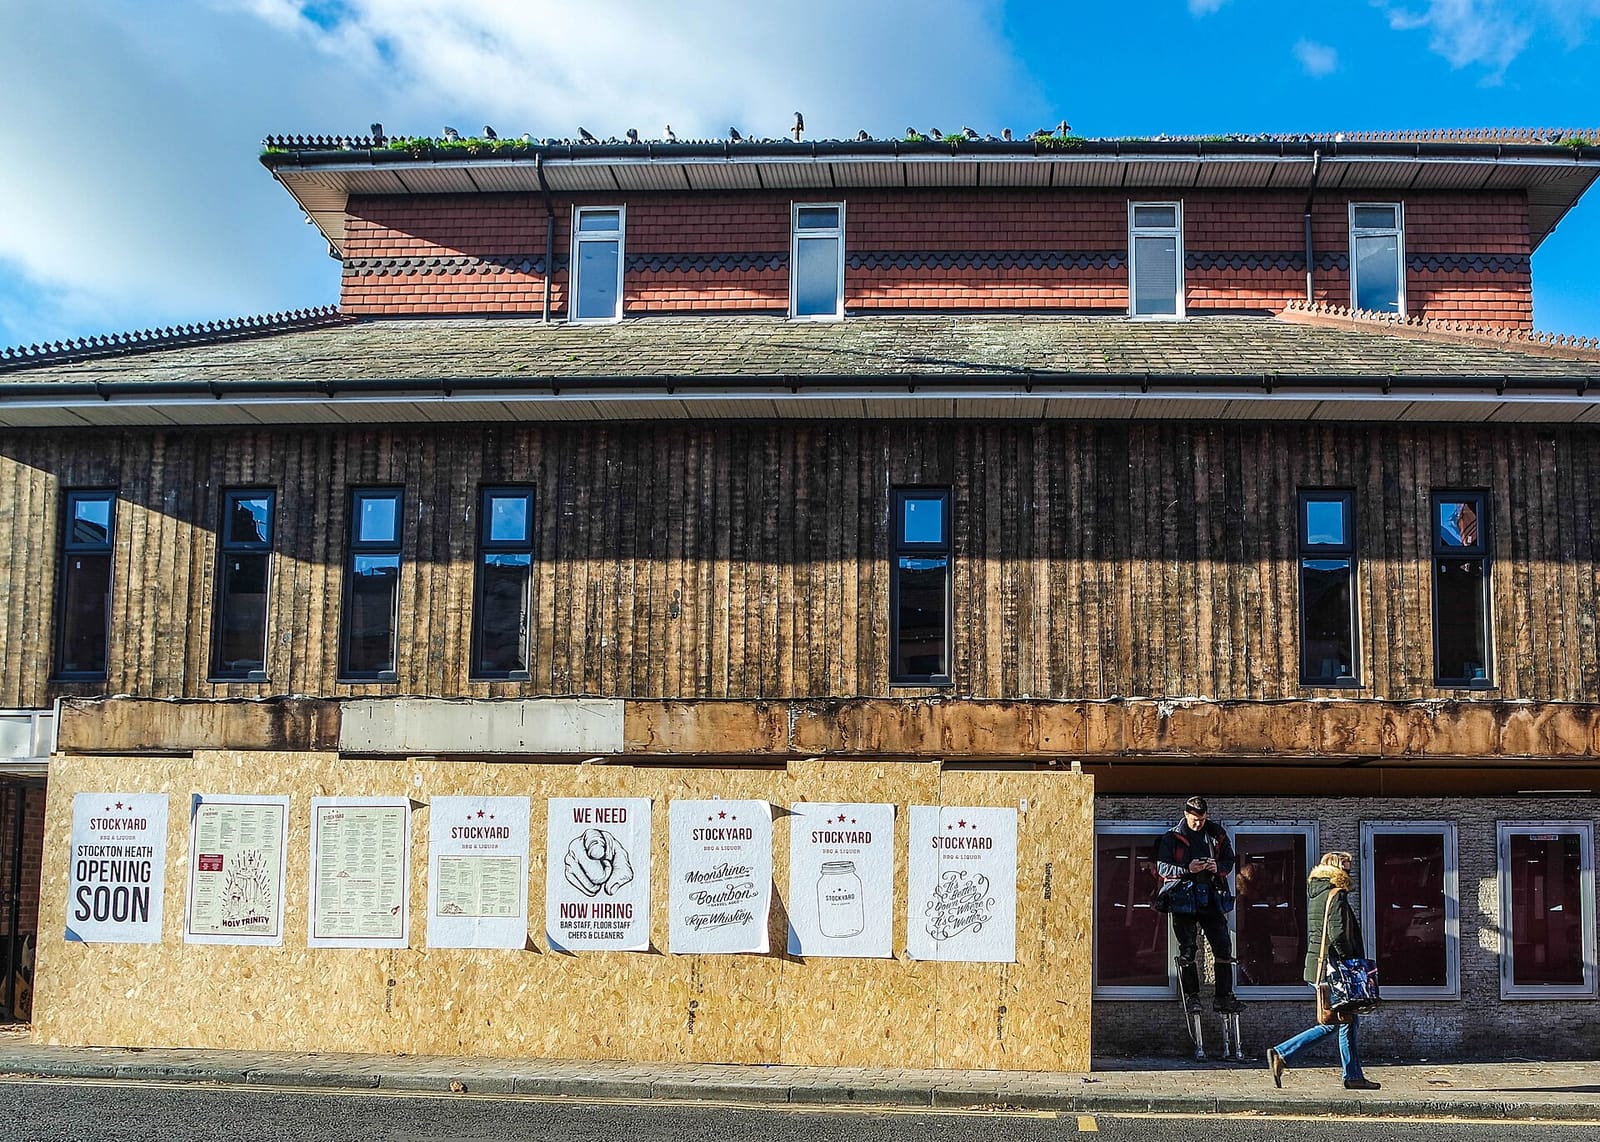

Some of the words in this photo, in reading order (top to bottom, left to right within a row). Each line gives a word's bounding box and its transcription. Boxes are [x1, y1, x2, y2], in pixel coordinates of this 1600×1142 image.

[573, 807, 592, 823] WE
[595, 807, 627, 823] NEED
[90, 818, 147, 831] STOCKYARD
[451, 826, 510, 839] STOCKYARD
[692, 828, 752, 841] STOCKYARD
[811, 831, 872, 844] STOCKYARD
[931, 836, 993, 850] STOCKYARD
[77, 845, 123, 857] STOCKTON
[125, 846, 153, 858] HEATH
[76, 859, 151, 883] OPENING
[685, 863, 753, 884] Moonshine
[689, 882, 758, 906] Bourbon
[75, 885, 150, 923] SOON
[560, 903, 588, 919] NOW
[591, 903, 633, 919] HIRING
[222, 919, 241, 927] HOLY
[241, 916, 270, 926] TRINITY
[560, 920, 573, 929] BAR
[573, 921, 593, 930] STAFF,
[593, 921, 613, 929] FLOOR
[613, 921, 631, 929] STAFF
[685, 914, 709, 931] Rye
[709, 909, 754, 926] Whiskey
[568, 931, 587, 940] CHEFS
[594, 932, 624, 940] CLEANERS
